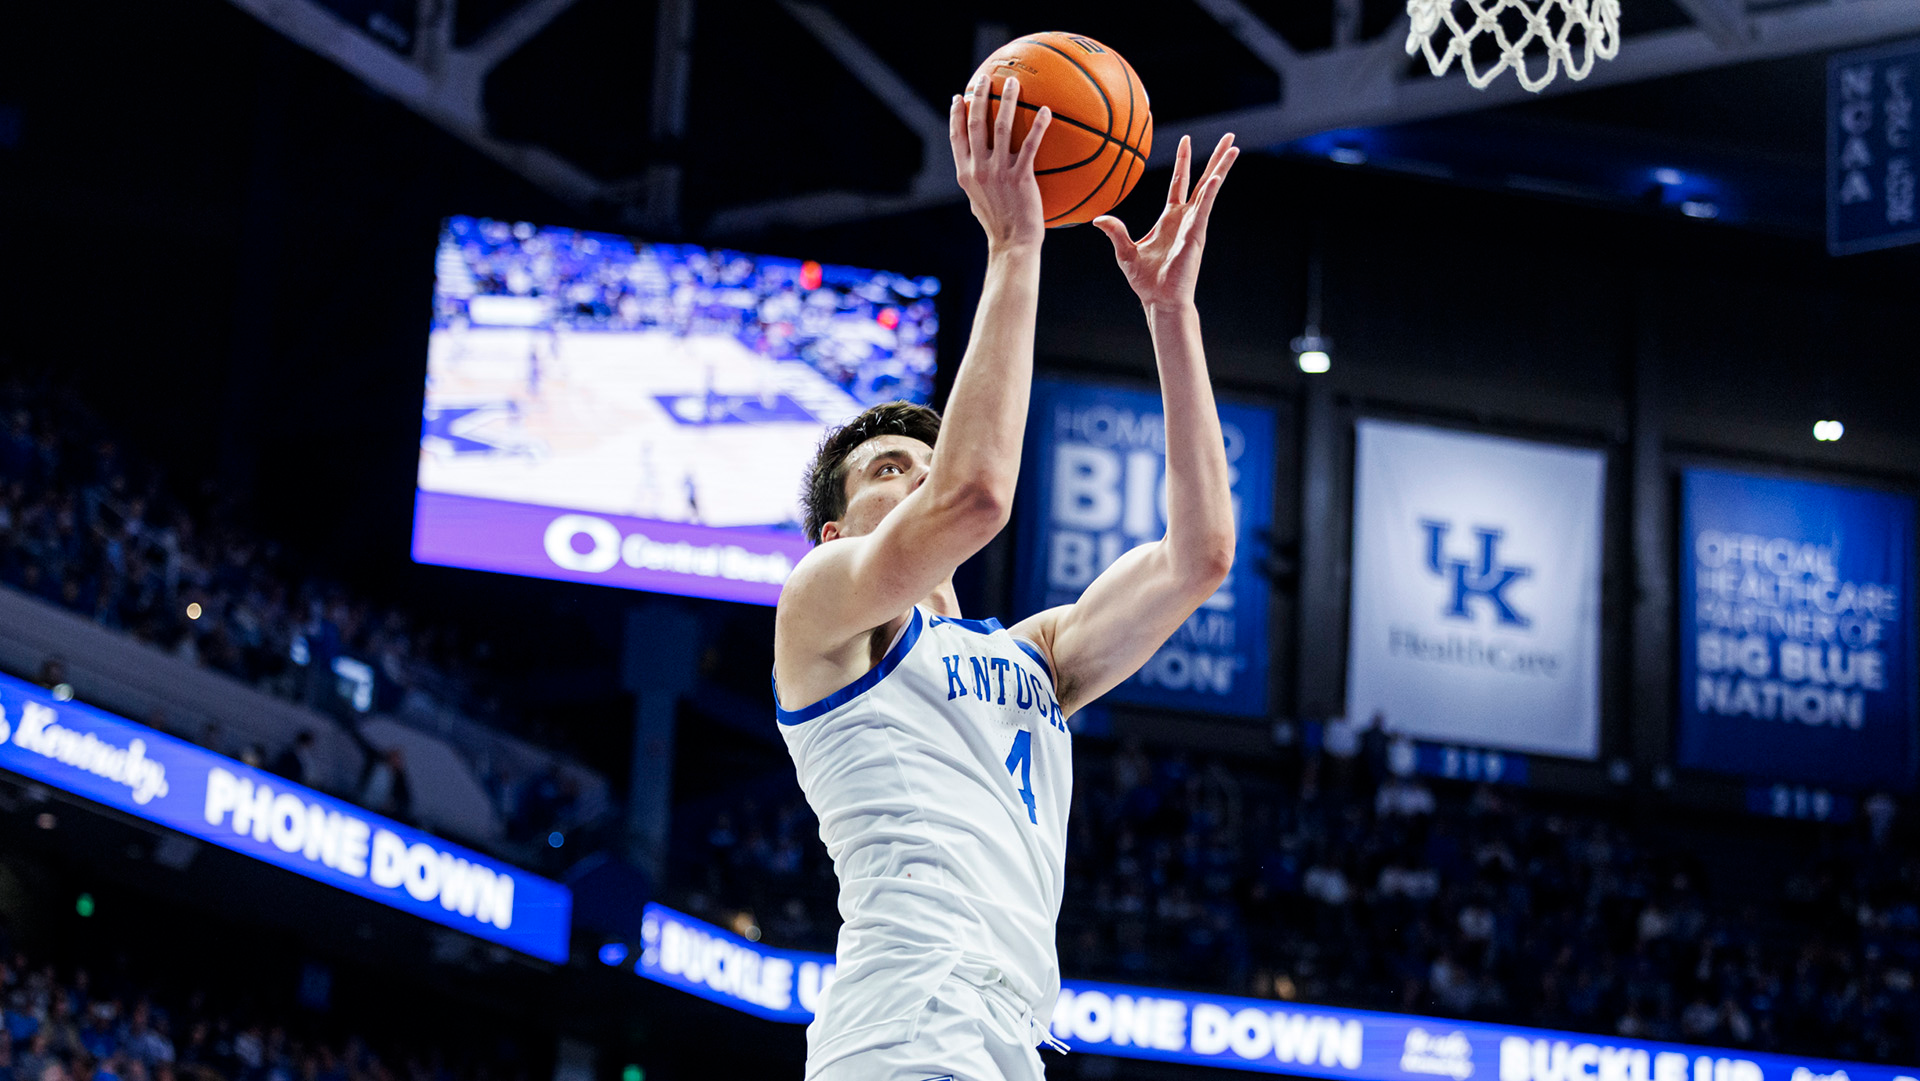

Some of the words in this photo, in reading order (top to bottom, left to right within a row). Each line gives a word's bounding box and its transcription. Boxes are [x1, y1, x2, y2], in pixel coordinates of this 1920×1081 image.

[1419, 518, 1533, 630] UK
[1696, 530, 1838, 583] OFFICIAL
[1696, 566, 1897, 622] HEALTHCARE
[1388, 627, 1558, 678] HealthCare
[1696, 600, 1837, 645] PARTNER
[1839, 609, 1882, 650] OF
[1697, 632, 1770, 678] BIG
[1779, 641, 1884, 690] BLUE
[1696, 673, 1864, 730] NATION
[1005, 729, 1038, 825] 4
[204, 767, 371, 878] PHONE
[370, 820, 515, 930] DOWN
[660, 920, 794, 1011] BUCKLE
[797, 960, 836, 1014] U
[1190, 1003, 1364, 1071] DOWN
[1500, 1036, 1690, 1081] BUCKLE
